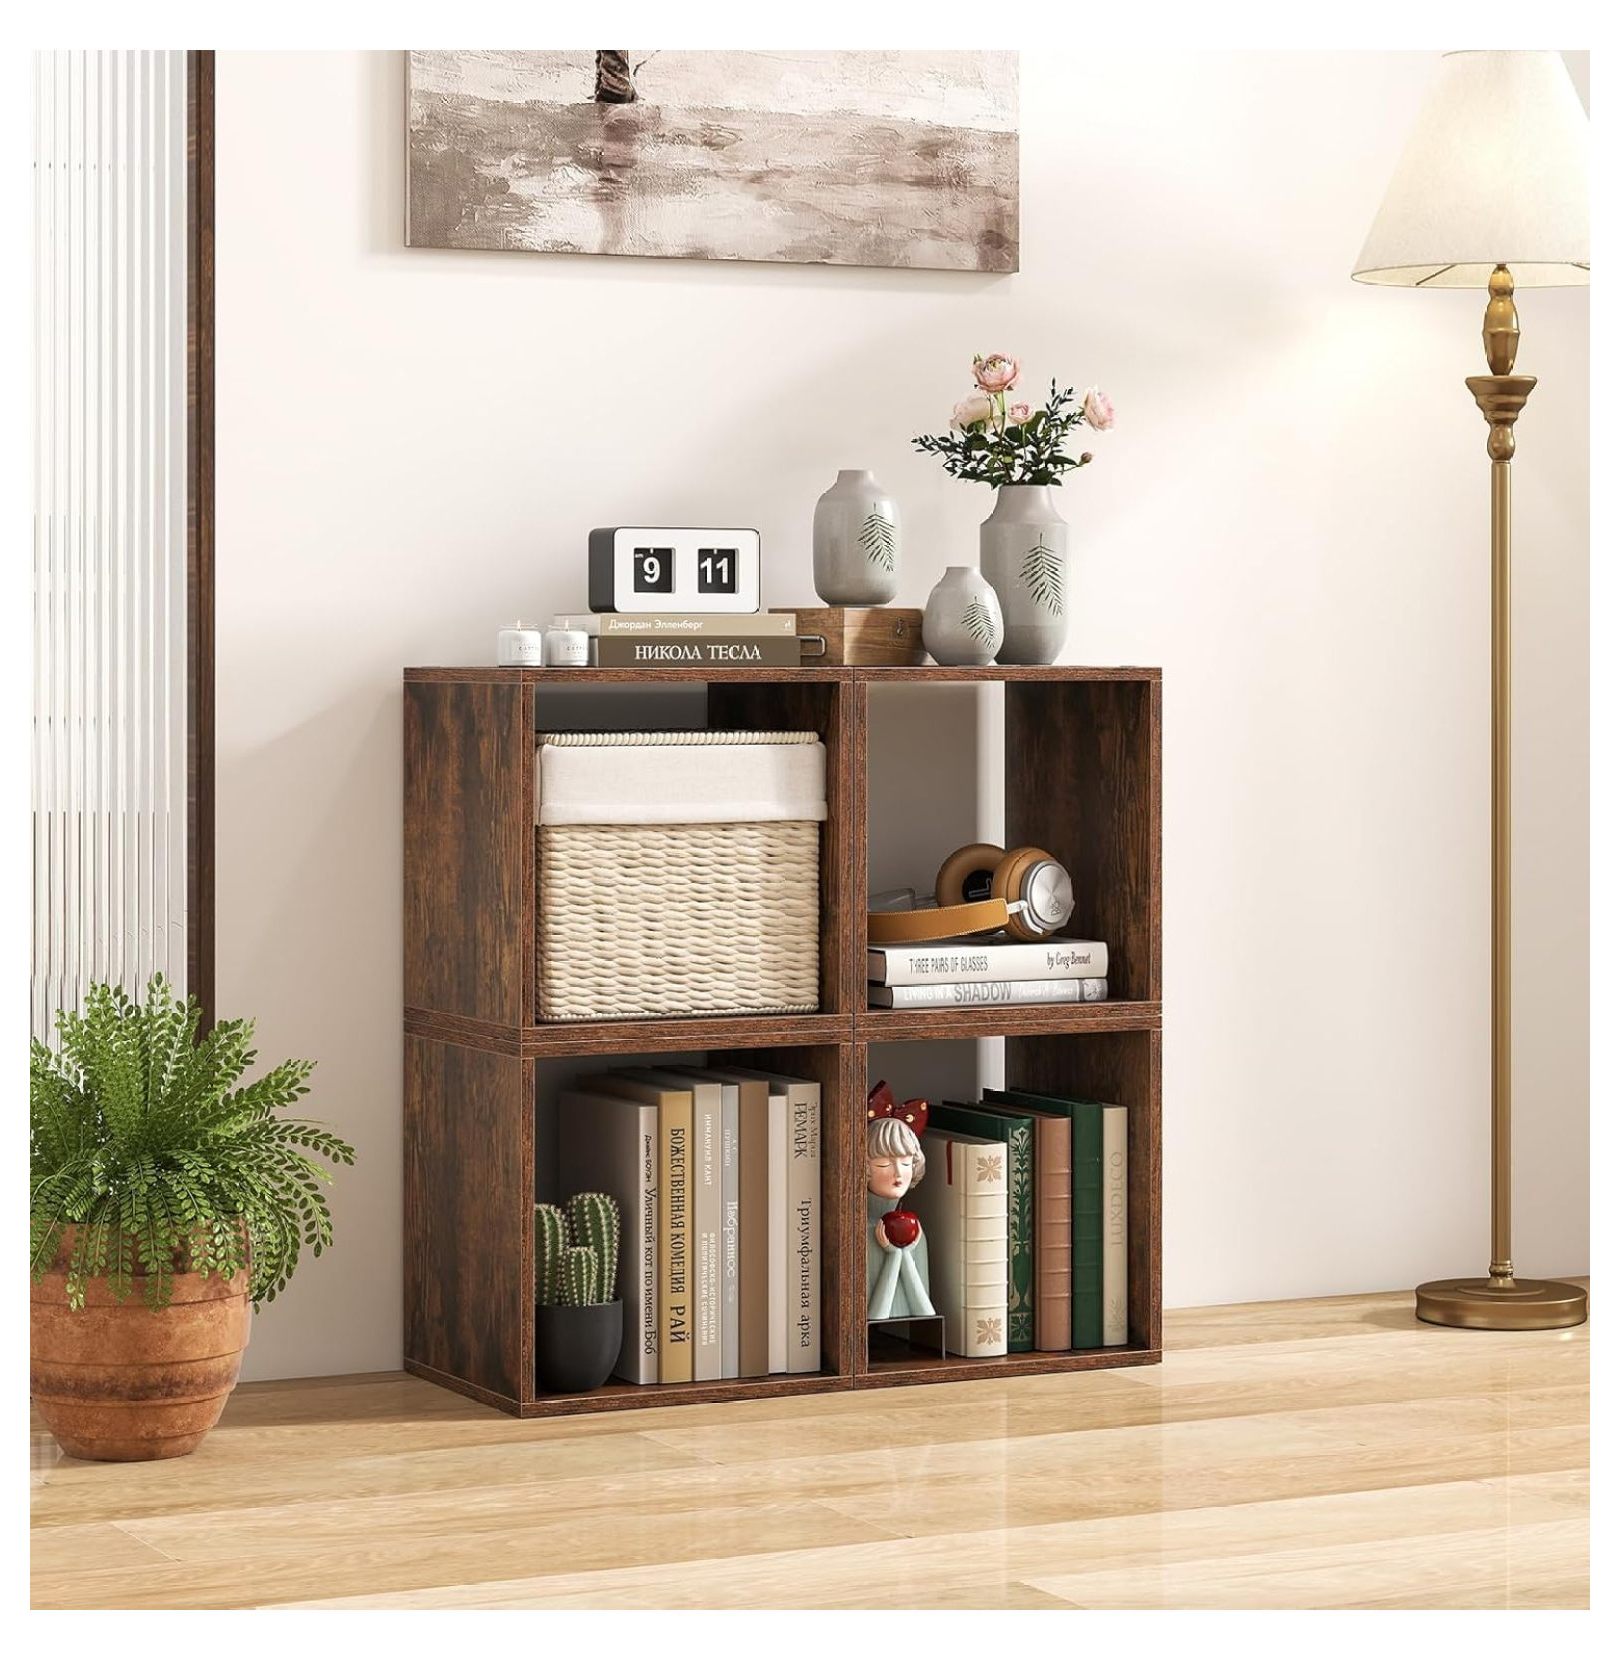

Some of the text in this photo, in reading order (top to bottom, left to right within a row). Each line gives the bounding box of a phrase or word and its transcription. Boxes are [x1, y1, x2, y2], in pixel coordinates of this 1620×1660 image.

[643, 556, 728, 584] 9 11
[608, 619, 704, 631] Джордан Элленберг
[634, 645, 762, 660] НИКОЛА ТЕСЛА
[960, 955, 988, 972] GLASSES
[954, 982, 1012, 1002] SHADOW
[794, 1103, 808, 1159] РЕМАРК
[644, 1188, 657, 1243] Уличный
[668, 1127, 686, 1294] БОЖЕСТВЕННАЯ КОМЕДИЯ
[645, 1247, 654, 1267] кот
[645, 1271, 654, 1286] по
[797, 1198, 812, 1348] Триумфальная арка
[645, 1288, 654, 1328] имени
[670, 1305, 690, 1343] РАЙ
[644, 1330, 657, 1355] Боб
